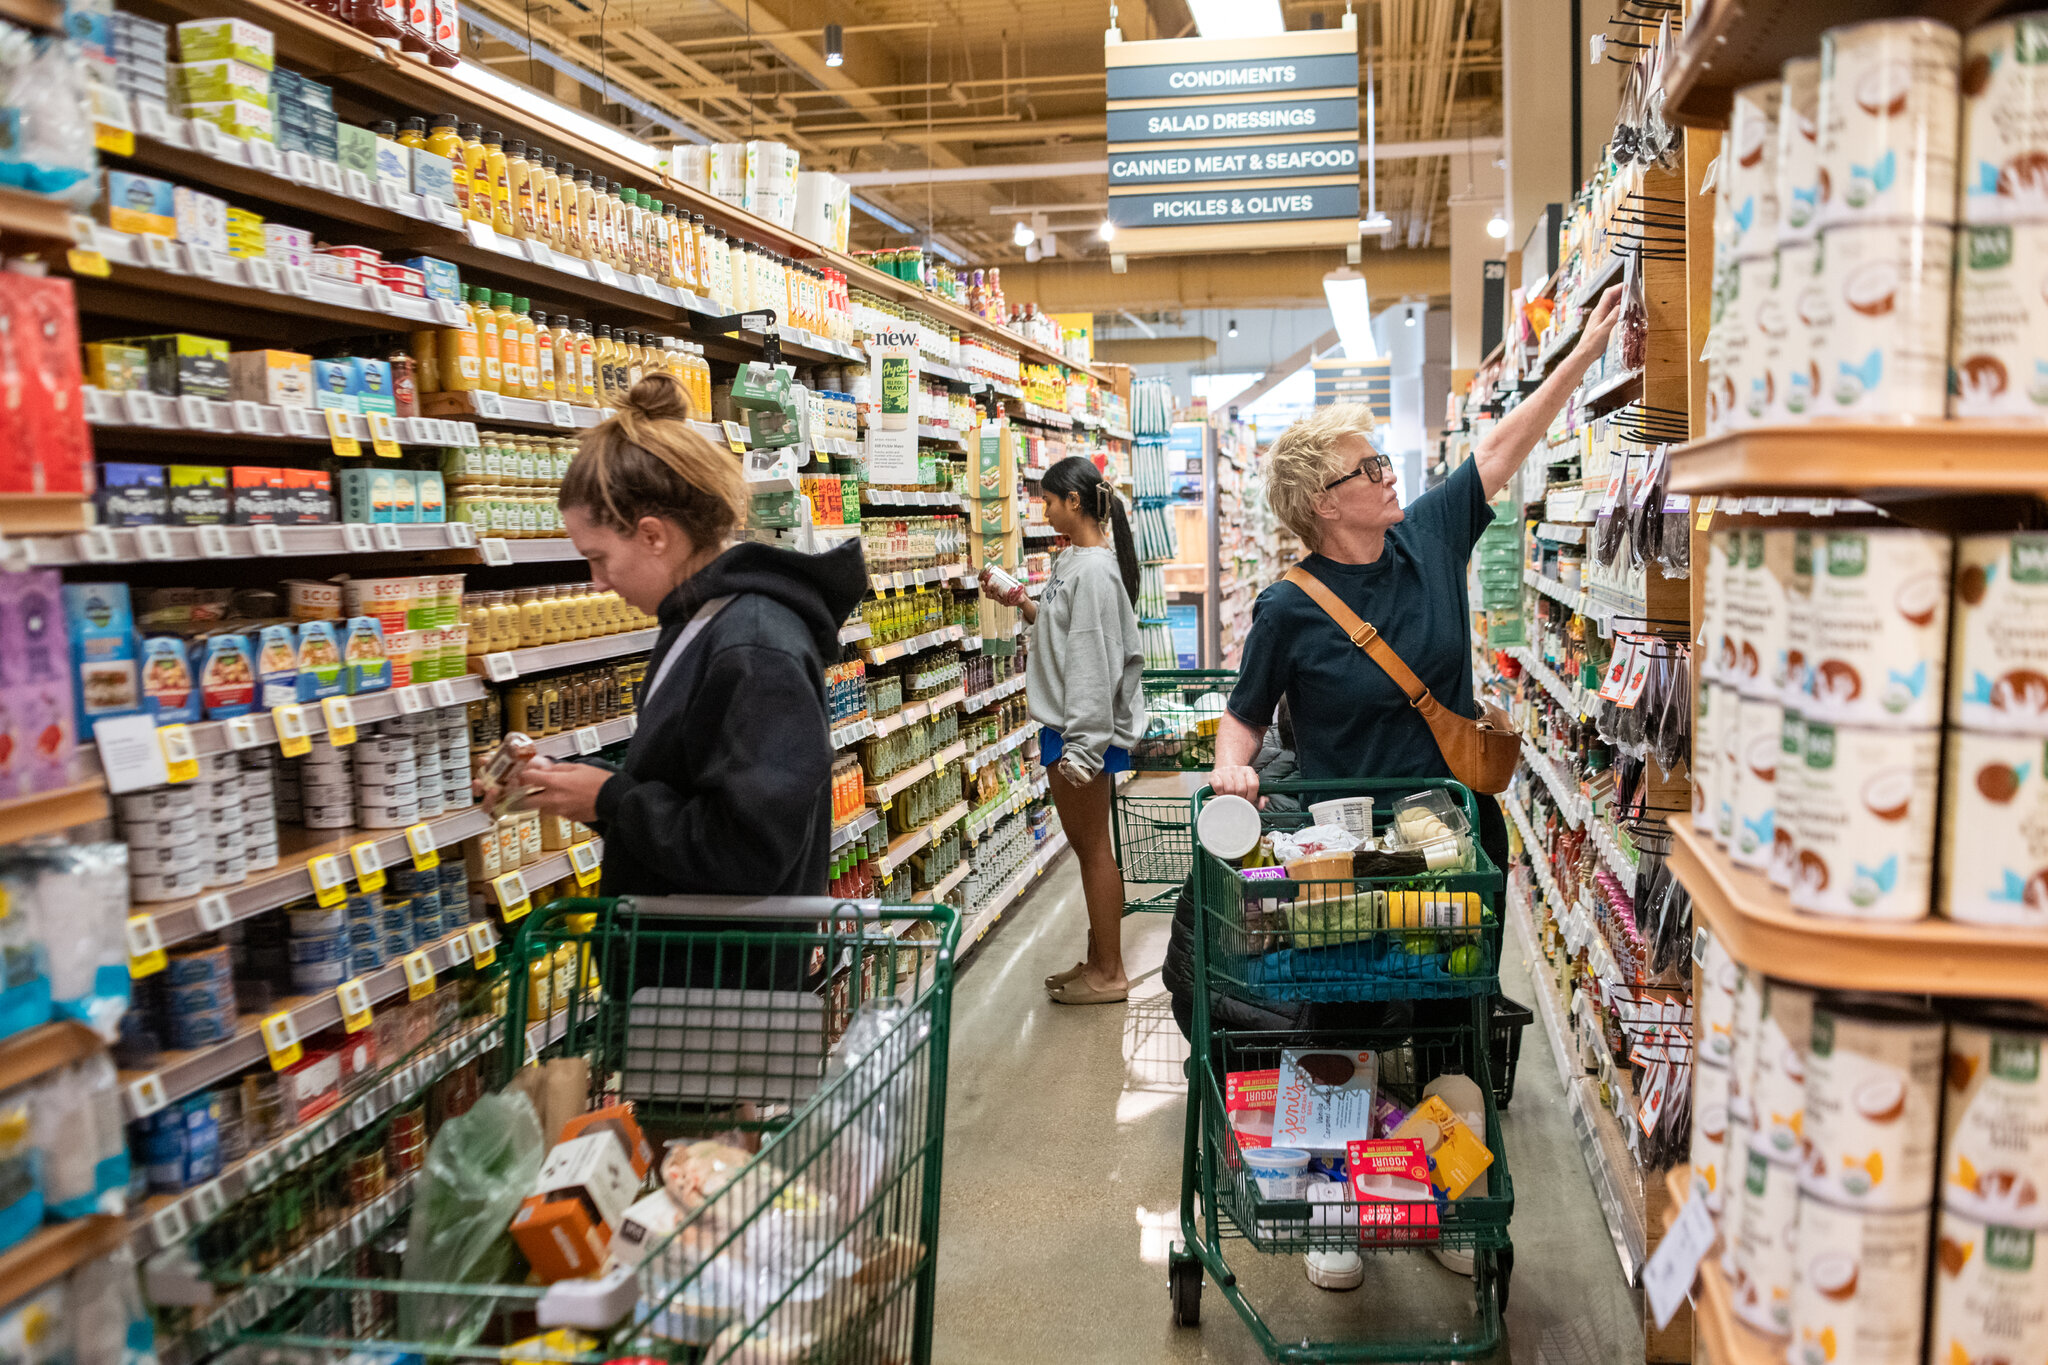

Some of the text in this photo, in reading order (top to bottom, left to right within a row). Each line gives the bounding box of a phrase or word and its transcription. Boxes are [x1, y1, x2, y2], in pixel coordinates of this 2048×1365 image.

[1169, 65, 1297, 89] CONDIMENTS
[1148, 108, 1316, 133] SALAD DRESSINGS
[1112, 149, 1356, 178] CANNED MEAT & SEAFOOD
[1153, 195, 1314, 218] PICKLES & OLIVES
[875, 332, 917, 346] new
[1245, 1090, 1277, 1102] YOGURT
[1279, 1077, 1307, 1144] jeni's
[1316, 1102, 1324, 1124] Vanilla
[1323, 1113, 1331, 1139] Caramel
[1372, 1156, 1408, 1167] YOGURT
